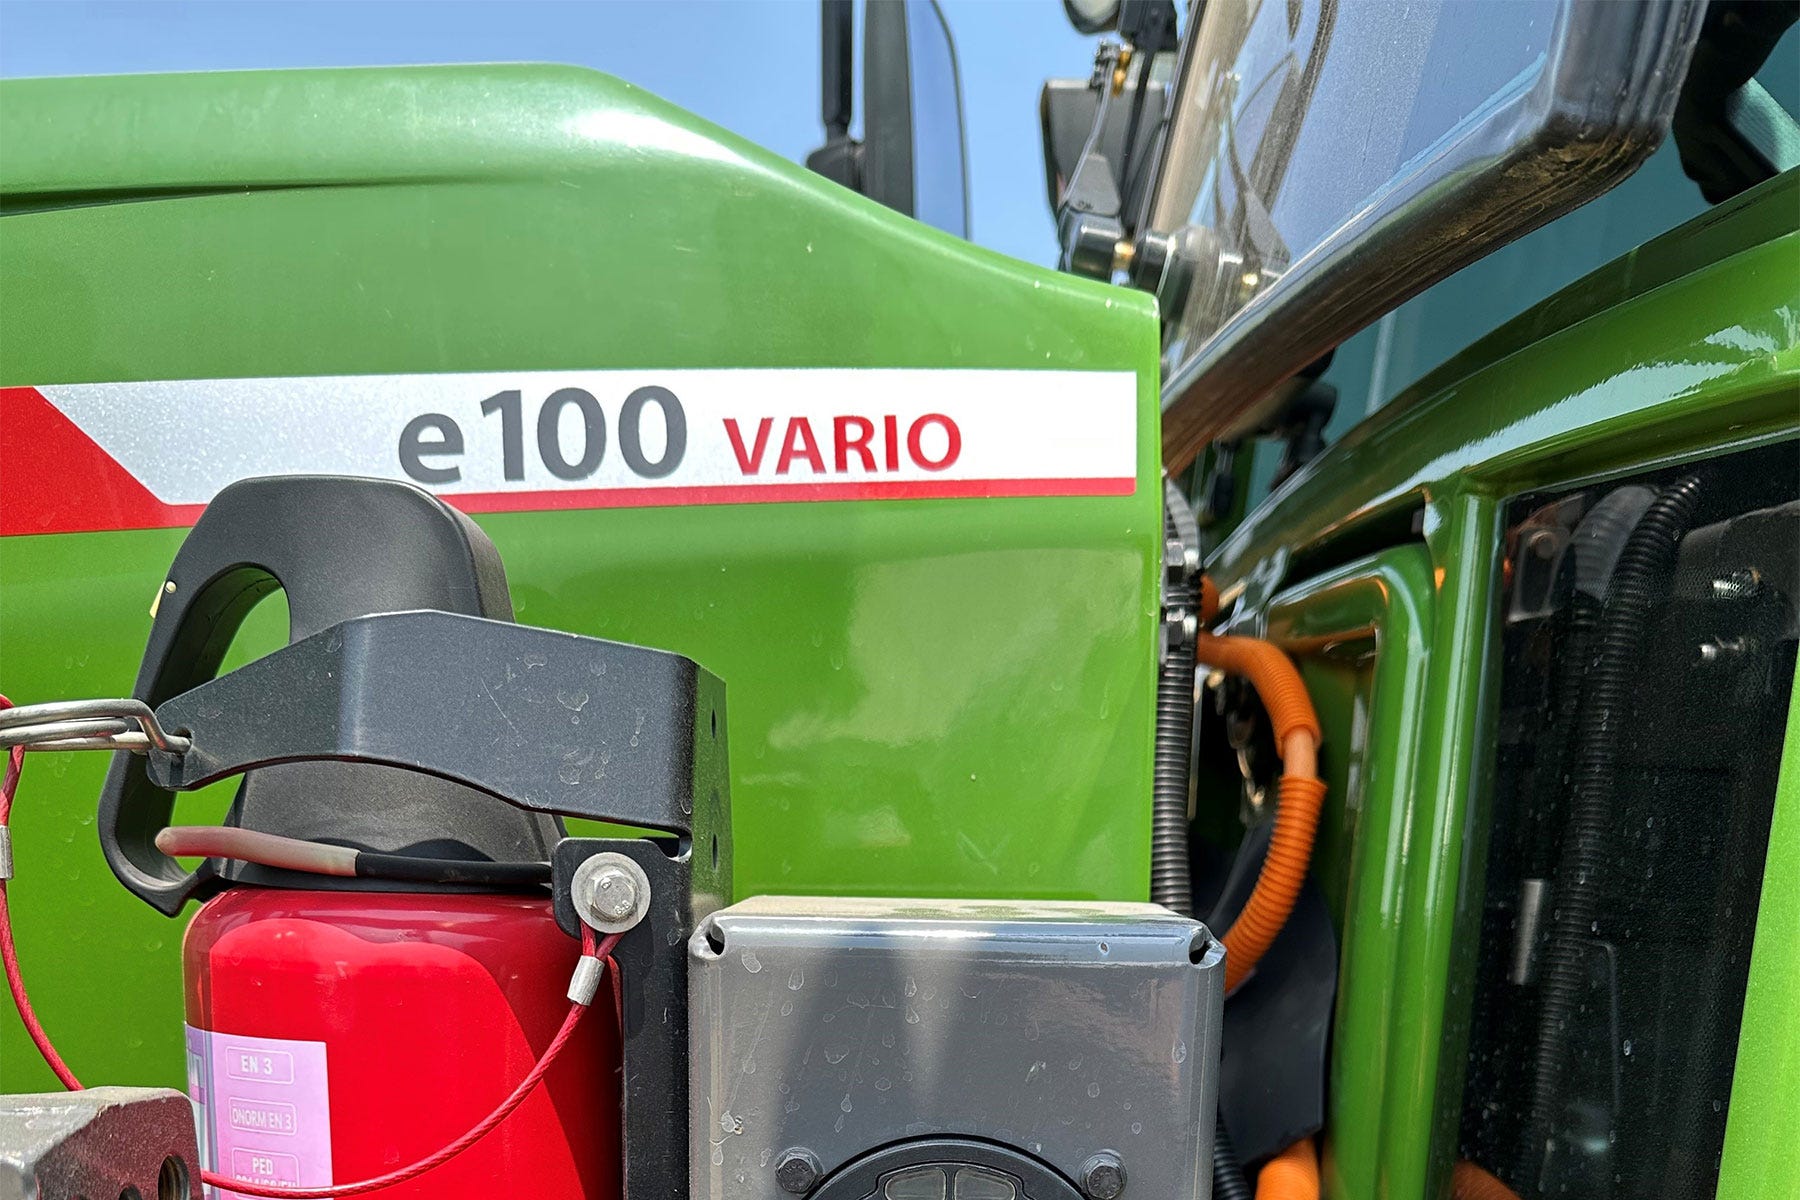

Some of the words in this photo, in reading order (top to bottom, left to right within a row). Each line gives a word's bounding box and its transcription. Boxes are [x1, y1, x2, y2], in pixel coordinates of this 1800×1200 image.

[398, 385, 688, 484] e100
[722, 413, 962, 476] VARIO
[240, 1055, 259, 1074] EN
[263, 1056, 273, 1075] 3
[269, 1112, 283, 1129] EN
[284, 1114, 292, 1130] 3
[252, 1157, 274, 1175] PED
